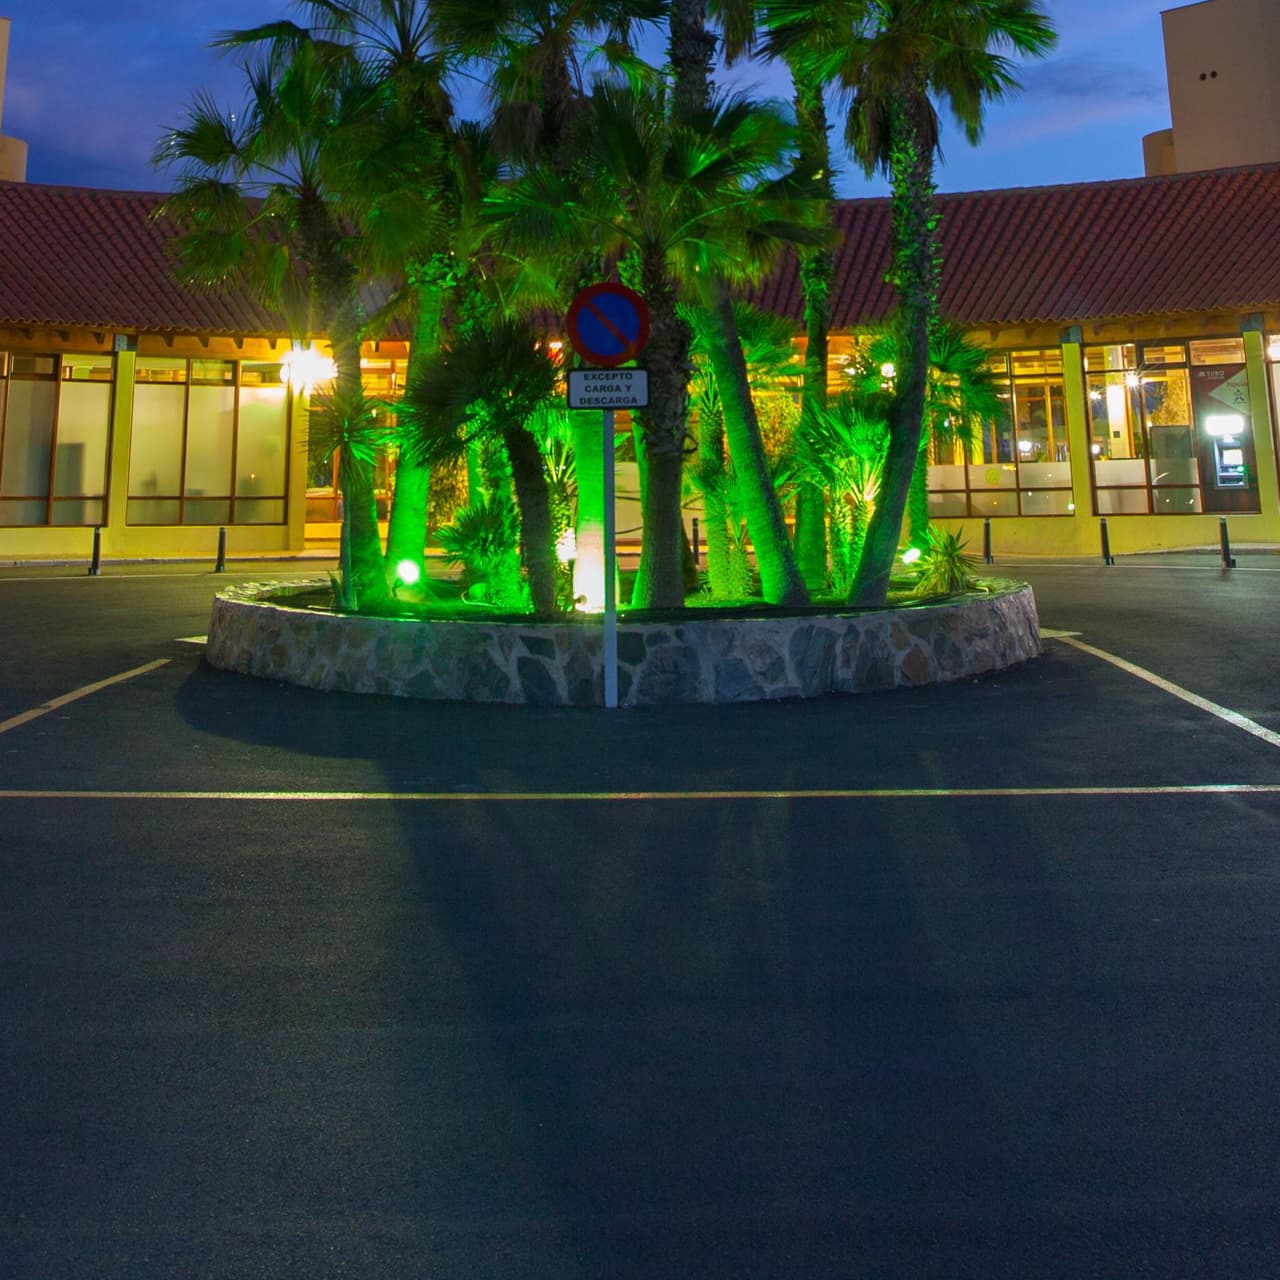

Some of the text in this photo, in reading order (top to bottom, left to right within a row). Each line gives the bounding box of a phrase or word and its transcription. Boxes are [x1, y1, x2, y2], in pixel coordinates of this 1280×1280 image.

[583, 372, 632, 380] EXCEPTO
[584, 384, 632, 392] CARGA Y
[579, 396, 638, 405] DESCARGA
